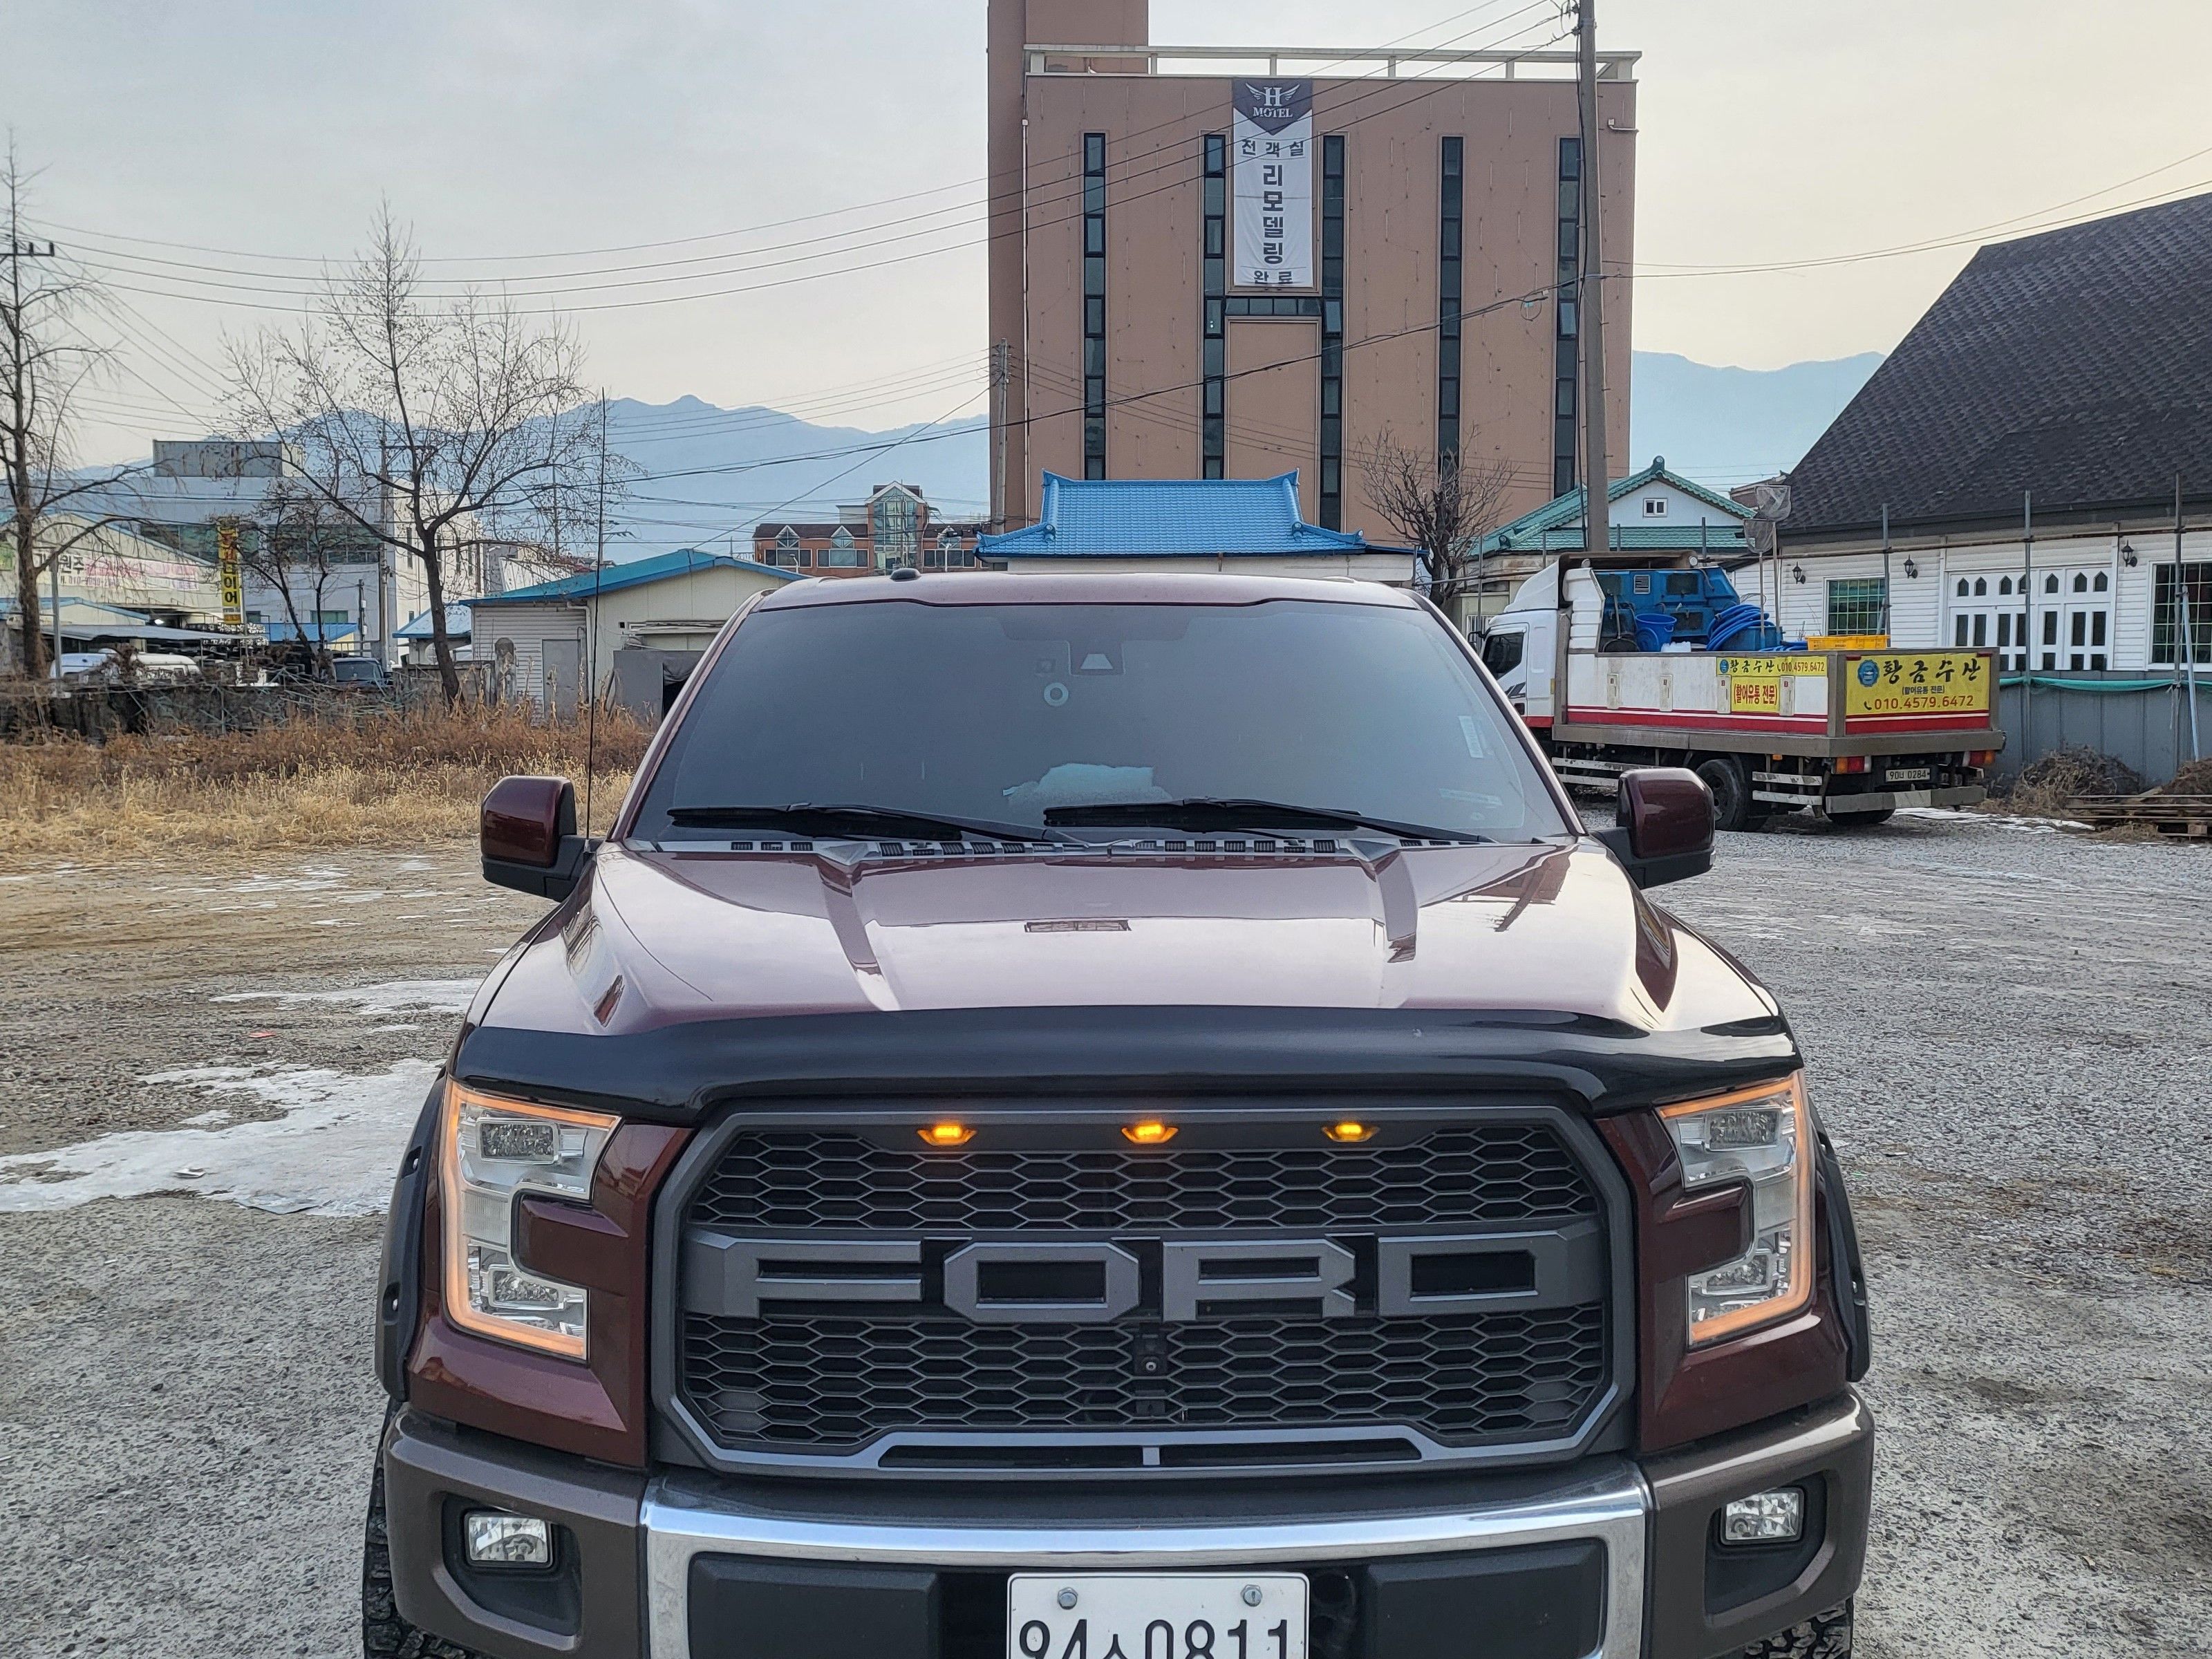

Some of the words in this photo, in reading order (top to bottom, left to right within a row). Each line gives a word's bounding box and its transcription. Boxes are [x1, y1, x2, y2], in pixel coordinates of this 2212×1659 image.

[1253, 107, 1293, 118] MOTEL
[1263, 165, 1284, 265] 리모델링
[1781, 662, 1825, 673] 010.4579.6472
[1762, 684, 1778, 705] 전문)
[1874, 695, 1974, 710] 010.4579.6472
[1907, 769, 1927, 779] 0284
[681, 1234, 1598, 1323] FORD
